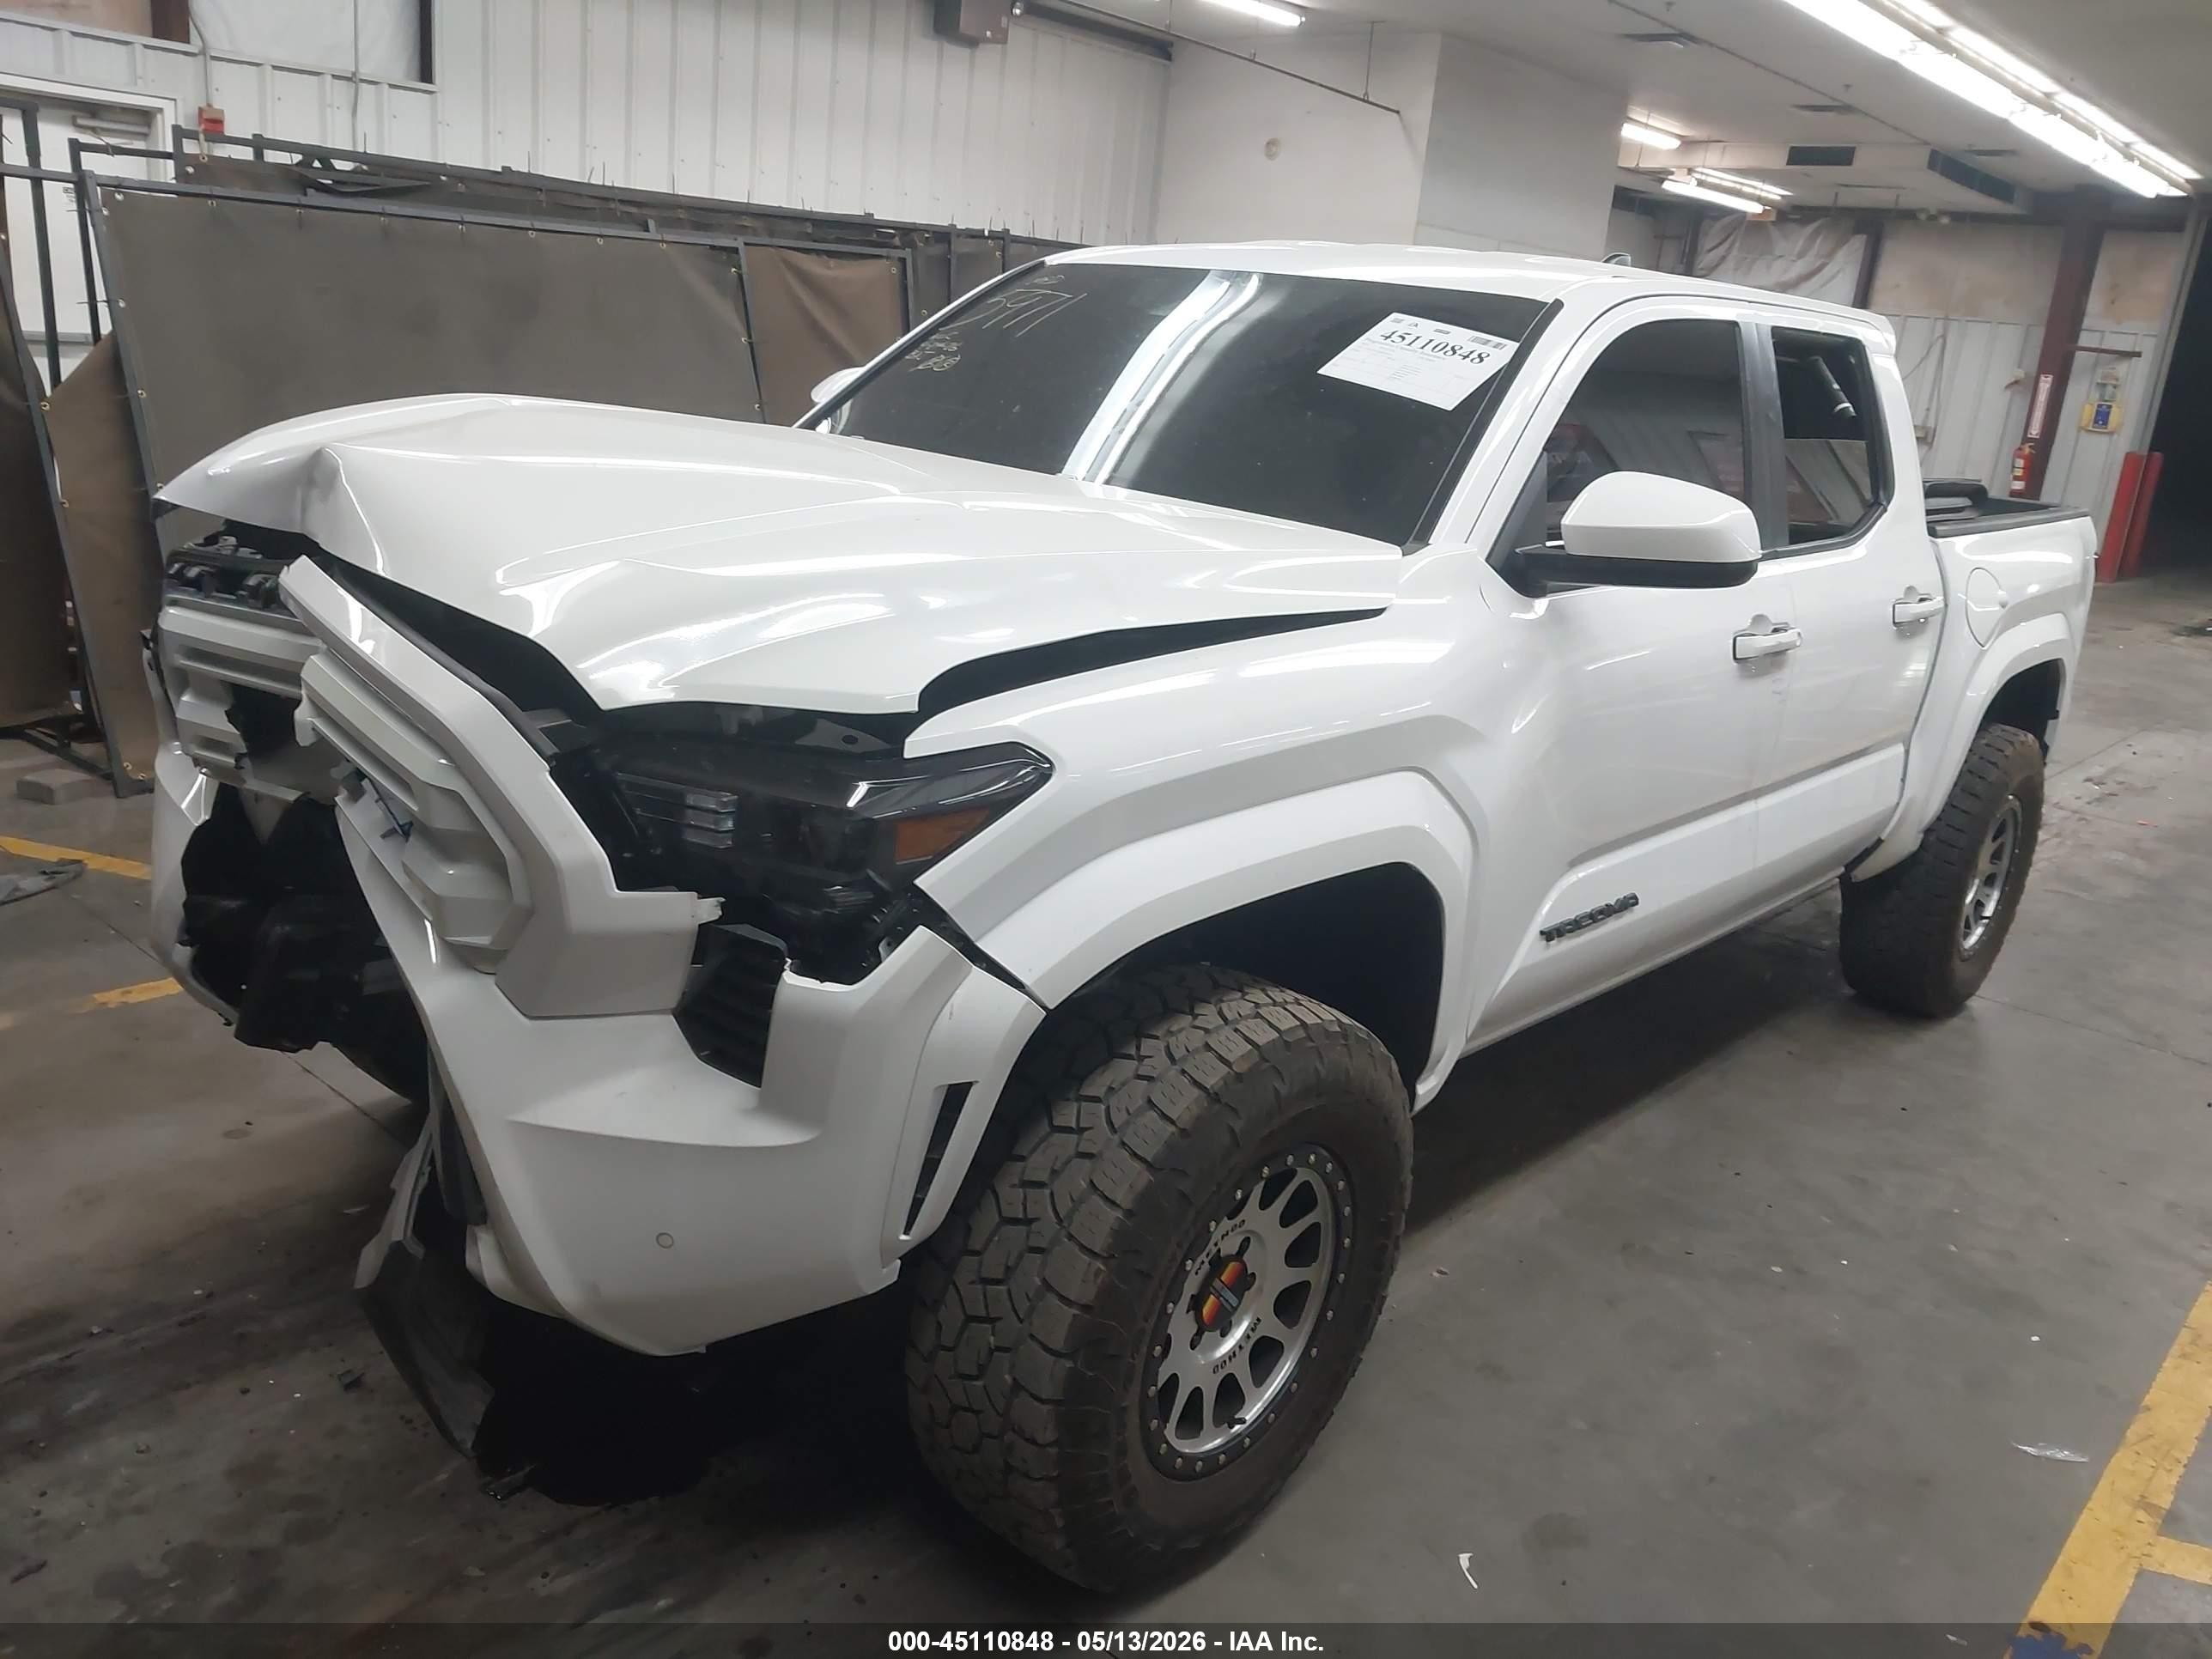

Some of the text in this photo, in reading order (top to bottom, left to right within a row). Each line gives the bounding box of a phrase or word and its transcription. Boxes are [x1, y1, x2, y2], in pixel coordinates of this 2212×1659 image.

[1380, 330, 1491, 365] 45110848
[1540, 892, 1639, 942] TACOMA
[1212, 1317, 1262, 1374] METHOD
